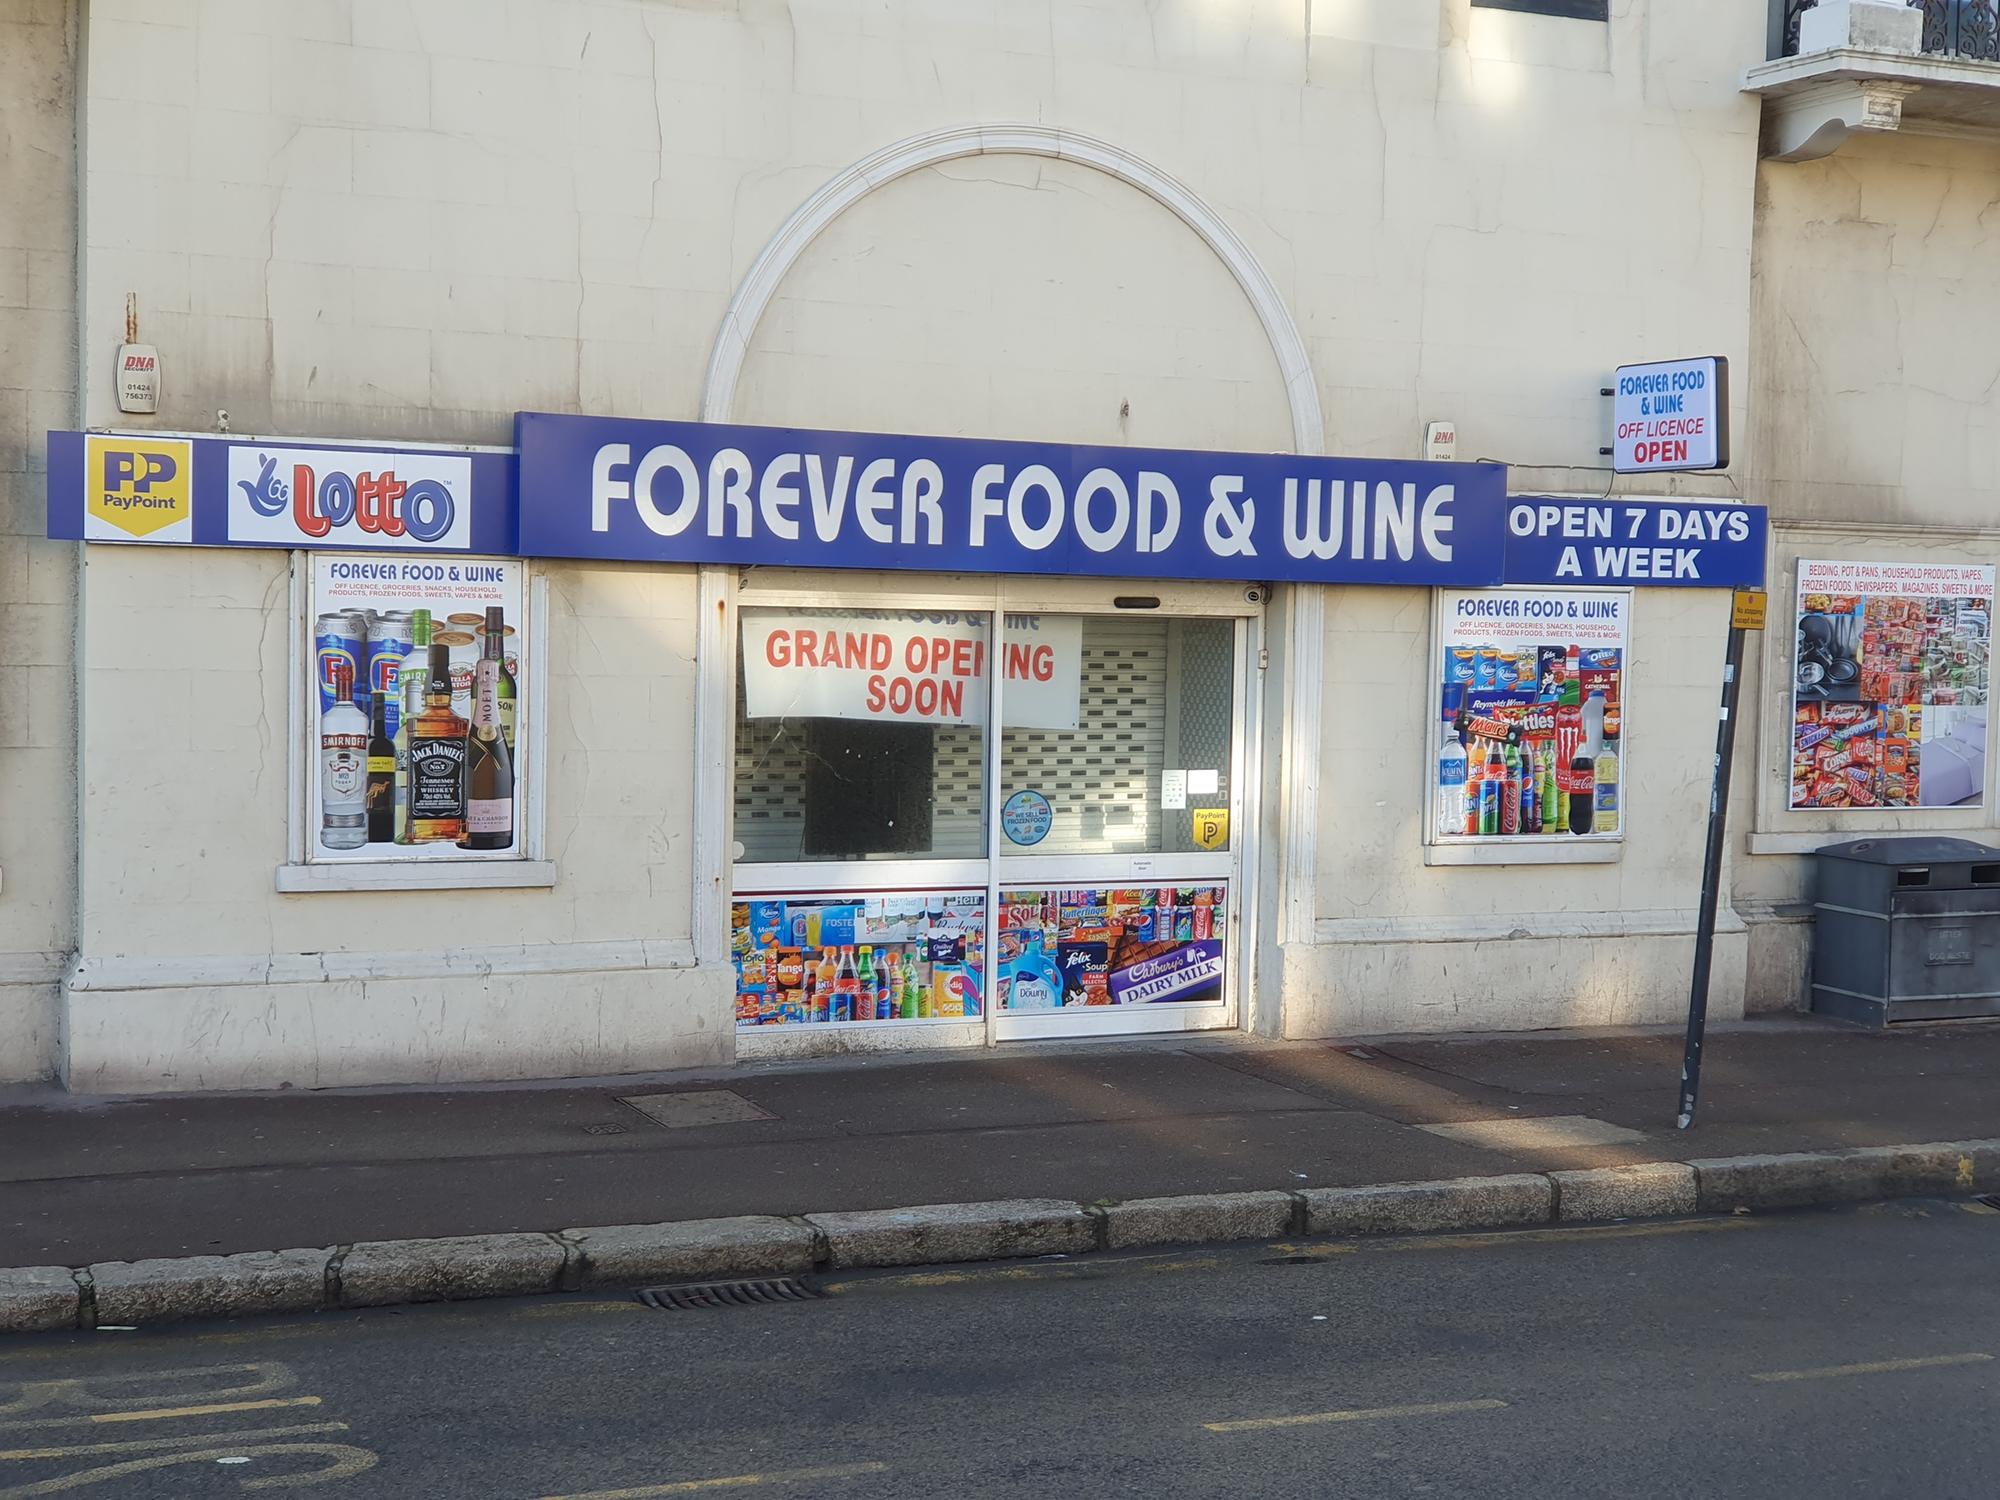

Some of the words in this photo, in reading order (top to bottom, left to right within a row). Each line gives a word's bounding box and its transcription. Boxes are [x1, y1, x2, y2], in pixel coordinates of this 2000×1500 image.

[125, 356, 155, 368] DNA
[1620, 373, 1669, 396] FOREVER
[1672, 370, 1705, 391] FOOD
[1641, 397, 1650, 415] &
[1654, 394, 1683, 415] WINE
[1434, 431, 1454, 441] DNA
[1618, 422, 1644, 439] OFF
[1646, 418, 1704, 438] LICENCE
[1634, 440, 1687, 463] OPEN
[104, 494, 176, 510] PayPoint
[592, 443, 944, 545] FOREVER
[969, 464, 1181, 553] FOOD
[1203, 475, 1258, 557] &
[1283, 478, 1455, 562] WINE
[1509, 505, 1612, 538] OPEN
[1625, 508, 1647, 539] 7
[1658, 509, 1750, 542] DAYS
[331, 563, 397, 580] FOREVER
[402, 565, 444, 581] FOOD
[448, 566, 460, 581] &
[465, 566, 504, 582] WINE
[1555, 546, 1583, 577] A
[1594, 547, 1701, 579] WEEK
[1809, 564, 1840, 577] BEDDING,
[1841, 566, 1855, 576] POT
[1855, 566, 1860, 577] &
[1861, 567, 1880, 578] PANS,
[1882, 568, 1922, 579] HOUSEHOLD
[1923, 569, 1960, 581] PRODUCTS,
[1961, 569, 1983, 581] VAPES,
[1802, 580, 1828, 591] FROZEN
[1854, 581, 1899, 594] NEWSPAPERS,
[1902, 582, 1940, 595] MAGAZINES,
[1941, 583, 1968, 595] SWEETS
[1968, 584, 1973, 595] &
[1974, 584, 1993, 595] MORE
[1458, 599, 1519, 617] FOREVER
[1524, 600, 1563, 617] FOOD
[1567, 601, 1578, 618] &
[1583, 601, 1618, 618] WINE
[765, 629, 893, 671] GRAND
[866, 674, 964, 717] SOON
[1468, 716, 1510, 737] Mars
[323, 736, 366, 747] SMIRNOFF
[412, 746, 433, 763] JACK
[433, 742, 465, 762] DANIEL'S
[1196, 812, 1226, 820] PayPoint
[777, 963, 803, 975] Tango
[1129, 956, 1184, 983] Cadbury's
[1126, 975, 1174, 1003] DAIRY
[1178, 960, 1217, 985] MILK
[1020, 987, 1048, 1000] Downy
